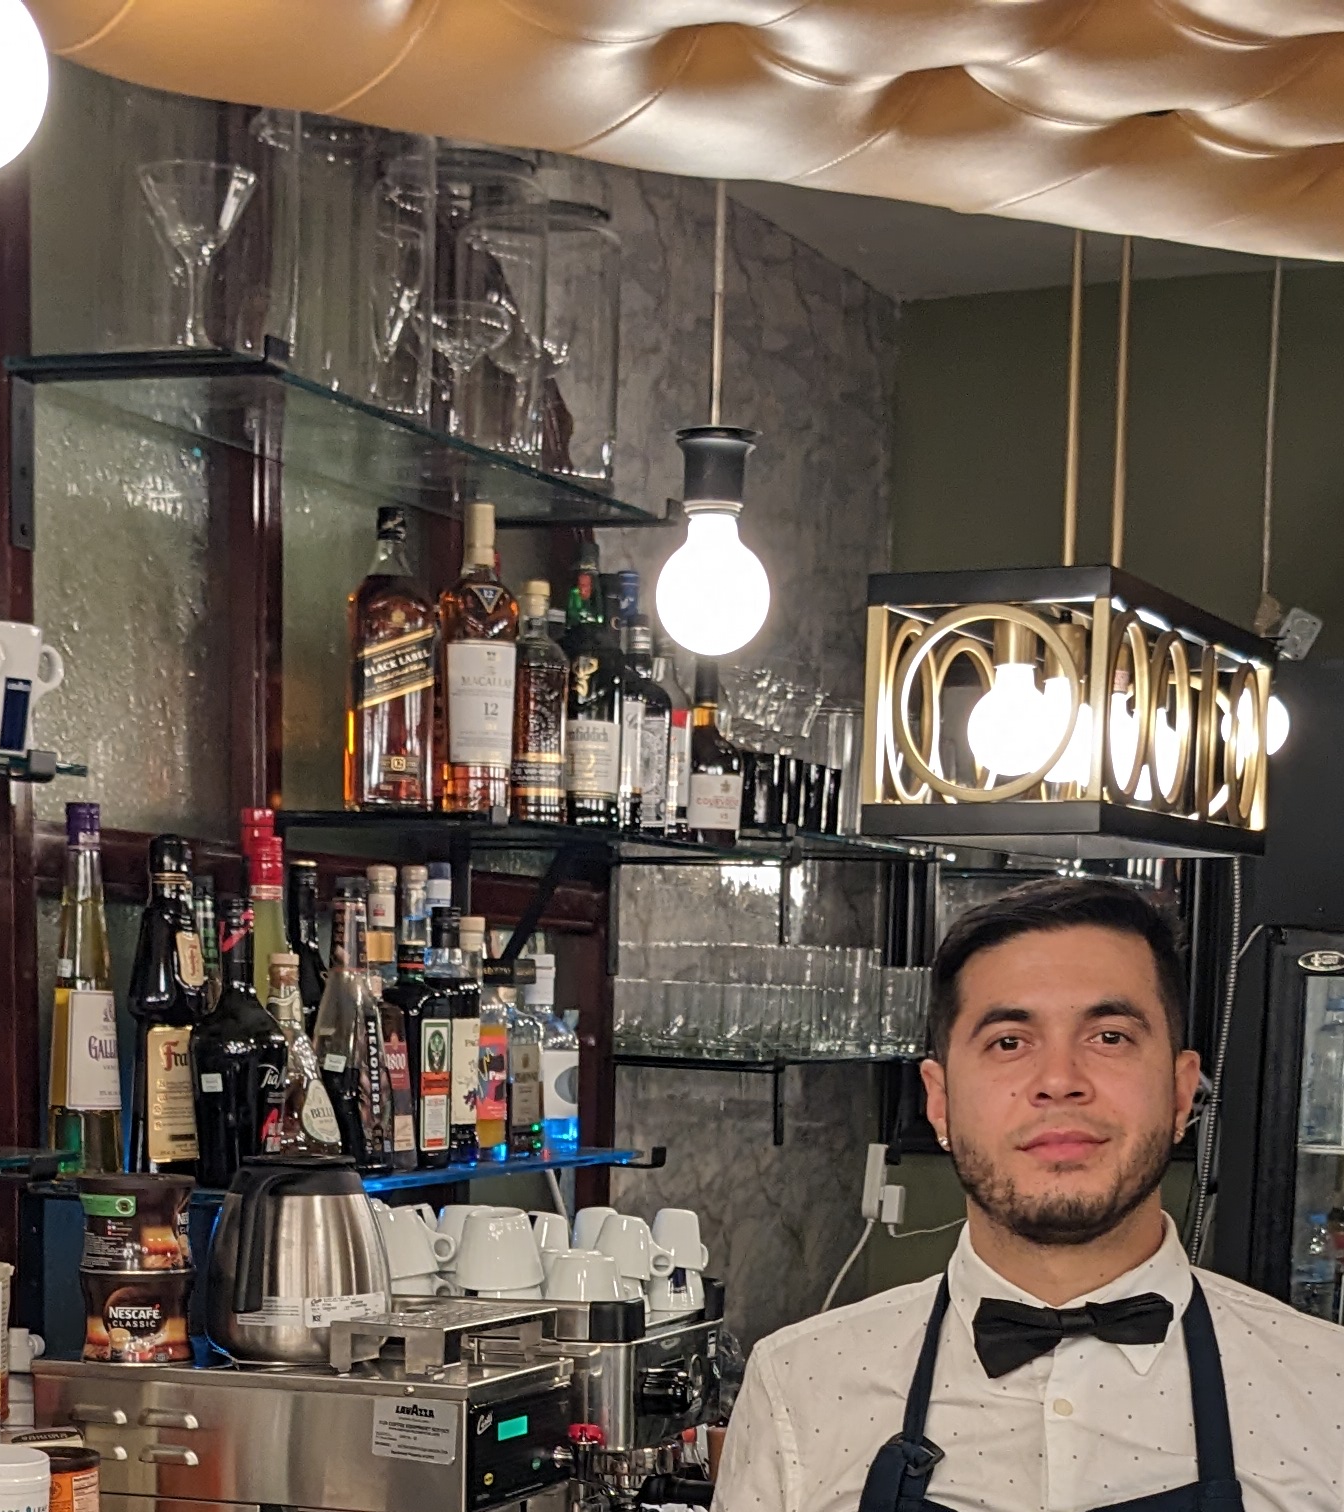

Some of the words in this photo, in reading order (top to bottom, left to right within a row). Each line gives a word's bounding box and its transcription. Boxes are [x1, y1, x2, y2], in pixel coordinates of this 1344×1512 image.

[364, 659, 397, 678] BLACK
[398, 649, 431, 667] LABEL
[483, 702, 499, 716] 12
[367, 1020, 381, 1115] MEAGHERS
[112, 1319, 157, 1328] CLASSIC
[395, 1404, 435, 1418] LAVAZZA
